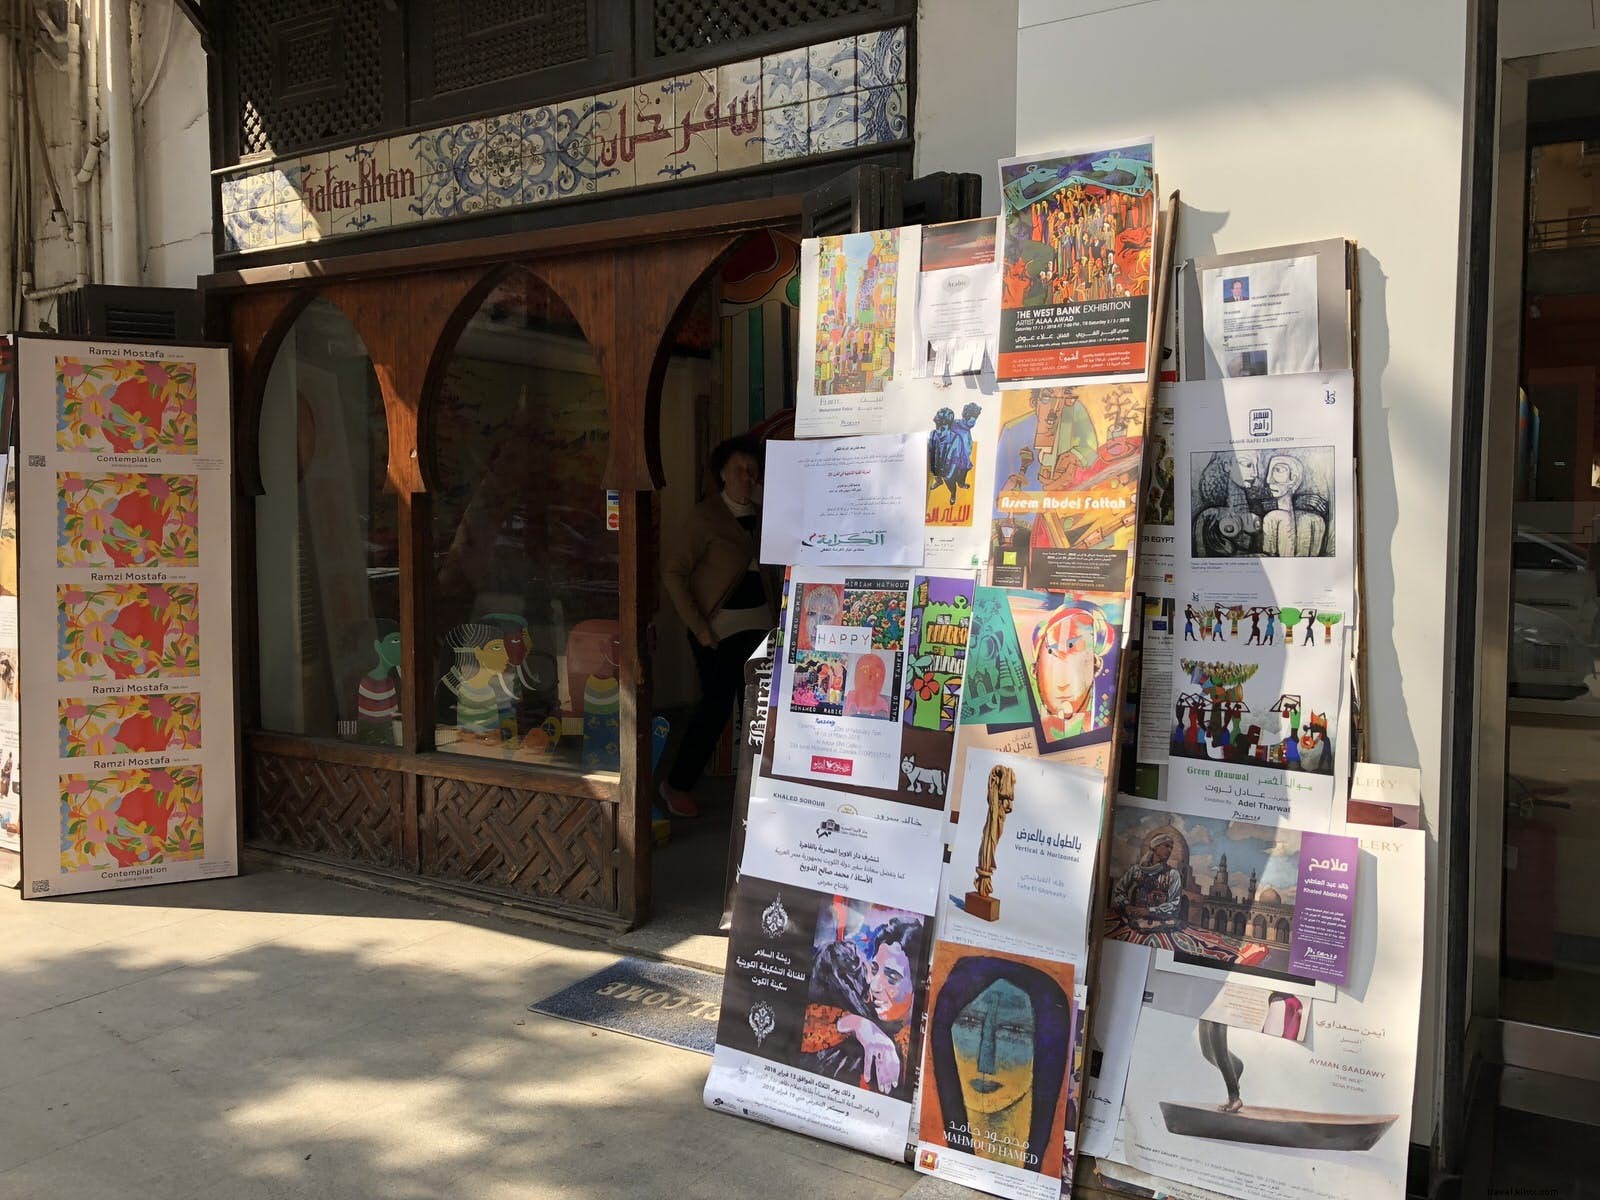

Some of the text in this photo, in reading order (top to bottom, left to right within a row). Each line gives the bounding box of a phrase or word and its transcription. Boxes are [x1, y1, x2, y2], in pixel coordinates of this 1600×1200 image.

[597, 85, 761, 167] سفر خان
[354, 158, 415, 205] Khan
[1016, 300, 1131, 319] THE WEST BANK EXHIBITION
[89, 346, 121, 357] Ramzi
[123, 348, 165, 359] Mostafa
[96, 454, 162, 464] Contemplation
[1001, 496, 1126, 510] Assem Abdel Fattah
[1151, 535, 1175, 544] EGYPT
[91, 572, 124, 582] Ramzi
[126, 572, 167, 582] Mostafa
[876, 581, 908, 589] HATHOUT
[818, 633, 870, 646] HAPPY
[895, 652, 904, 678] TAHER
[92, 684, 124, 694] Ramzi
[127, 682, 169, 692] Mostafa
[93, 759, 126, 769] Ramzi
[128, 756, 170, 767] Mostafa
[1187, 766, 1249, 782] Green Mawwal
[1356, 777, 1398, 788] LERY
[773, 792, 826, 808] KHALED SOROUR
[1238, 800, 1291, 813] Adel Tharwat
[874, 813, 922, 826] خالد سرور
[1016, 828, 1082, 852] بالطول و بالعرض
[1360, 840, 1402, 852] LERY
[1014, 844, 1080, 863] Vertical & Horizontal
[1308, 858, 1348, 872] ملامح
[101, 866, 168, 880] Contemplation
[834, 870, 850, 878] محمد
[1304, 887, 1322, 895] Khaled
[754, 949, 791, 964] ريشة السلام
[1304, 946, 1338, 958] Picasso
[736, 956, 806, 980] للفنانة التشكيلية الكويتية
[752, 976, 788, 992] سكينة الكوت
[596, 980, 721, 1021] ELCOME
[764, 1065, 776, 1074] 2018
[1309, 1058, 1386, 1078] AYMAN SAADAWY
[762, 1083, 774, 1092] 2018
[950, 1120, 1030, 1149] محمود حامد
[942, 1130, 1039, 1165] MAHMOUD HAMED
